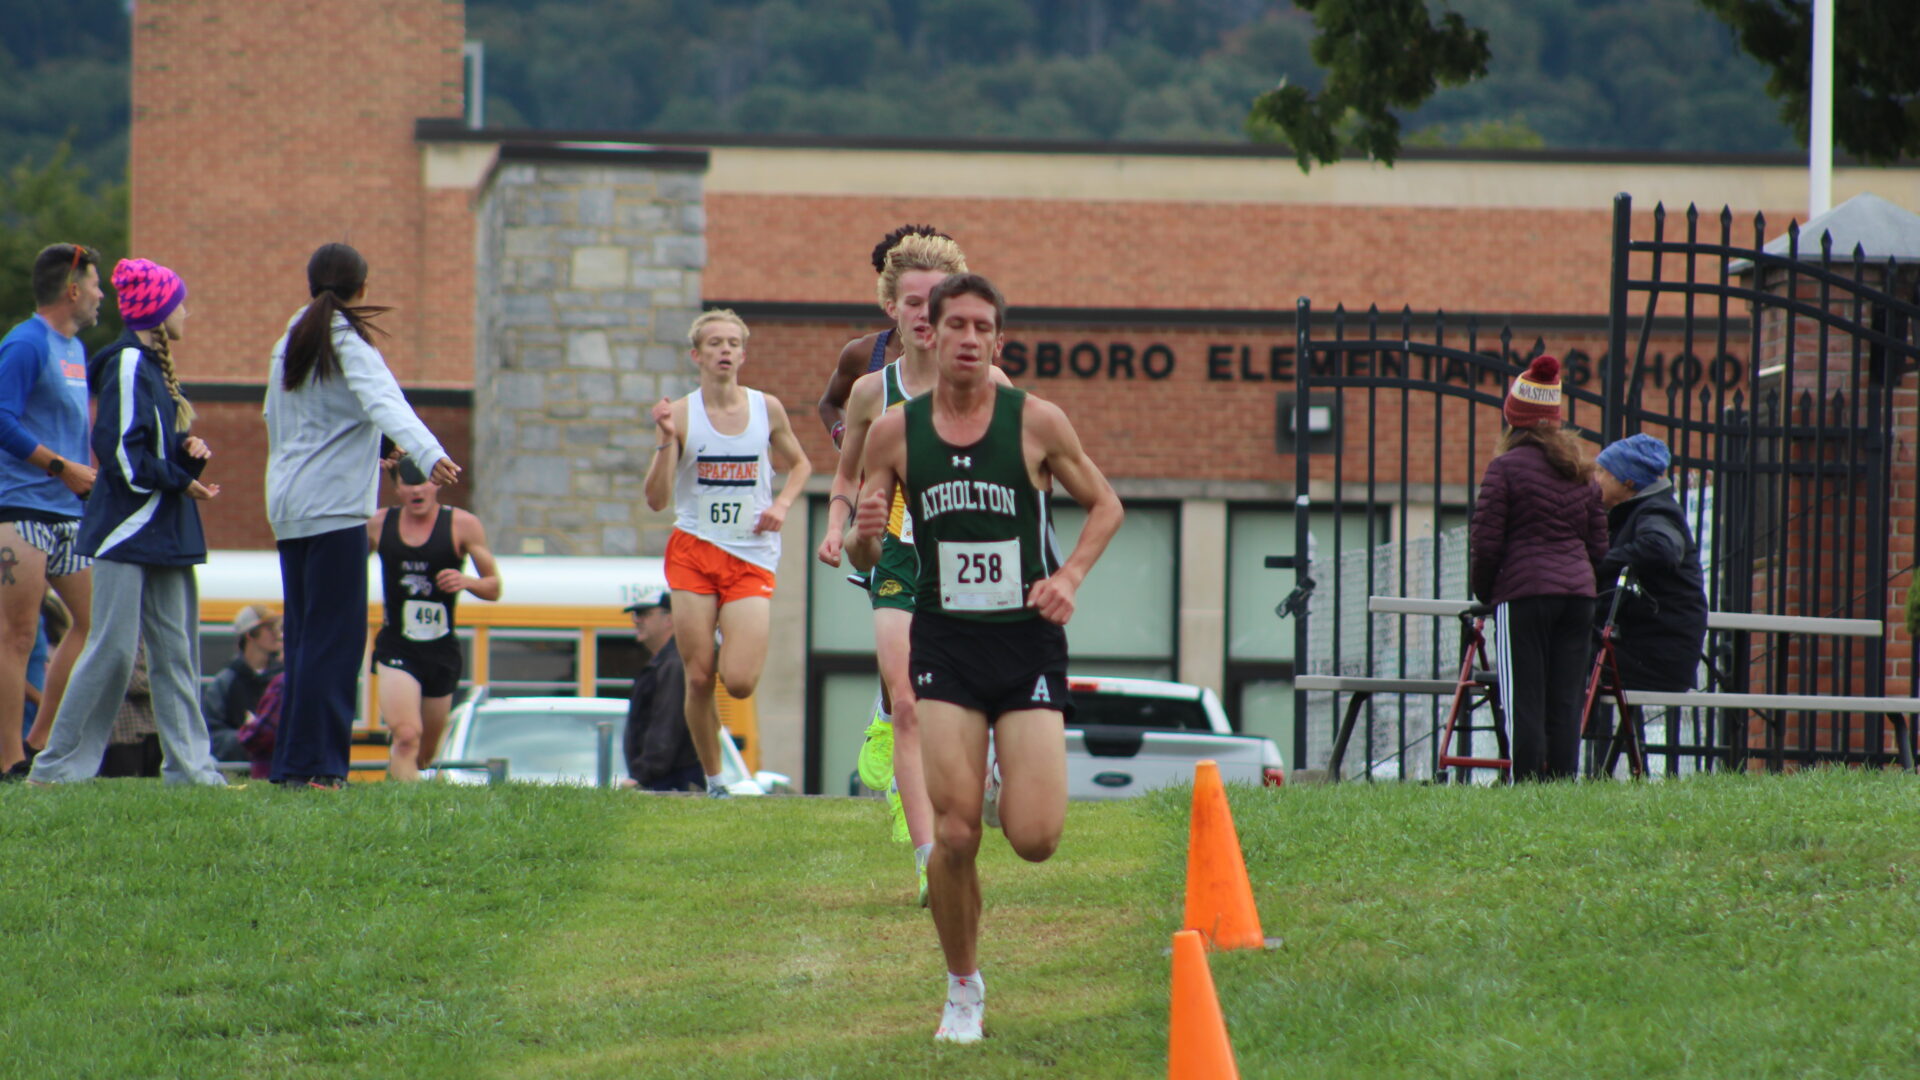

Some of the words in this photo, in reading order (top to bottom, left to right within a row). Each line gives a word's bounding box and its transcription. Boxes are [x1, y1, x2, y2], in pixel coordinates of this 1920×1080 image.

[1563, 350, 1752, 390] SCHOO
[696, 462, 759, 480] SPARTANS
[710, 502, 742, 524] 657
[921, 480, 1016, 522] ATHOLTON
[957, 552, 1003, 584] 258
[415, 607, 442, 624] 494
[1030, 674, 1052, 702] A
